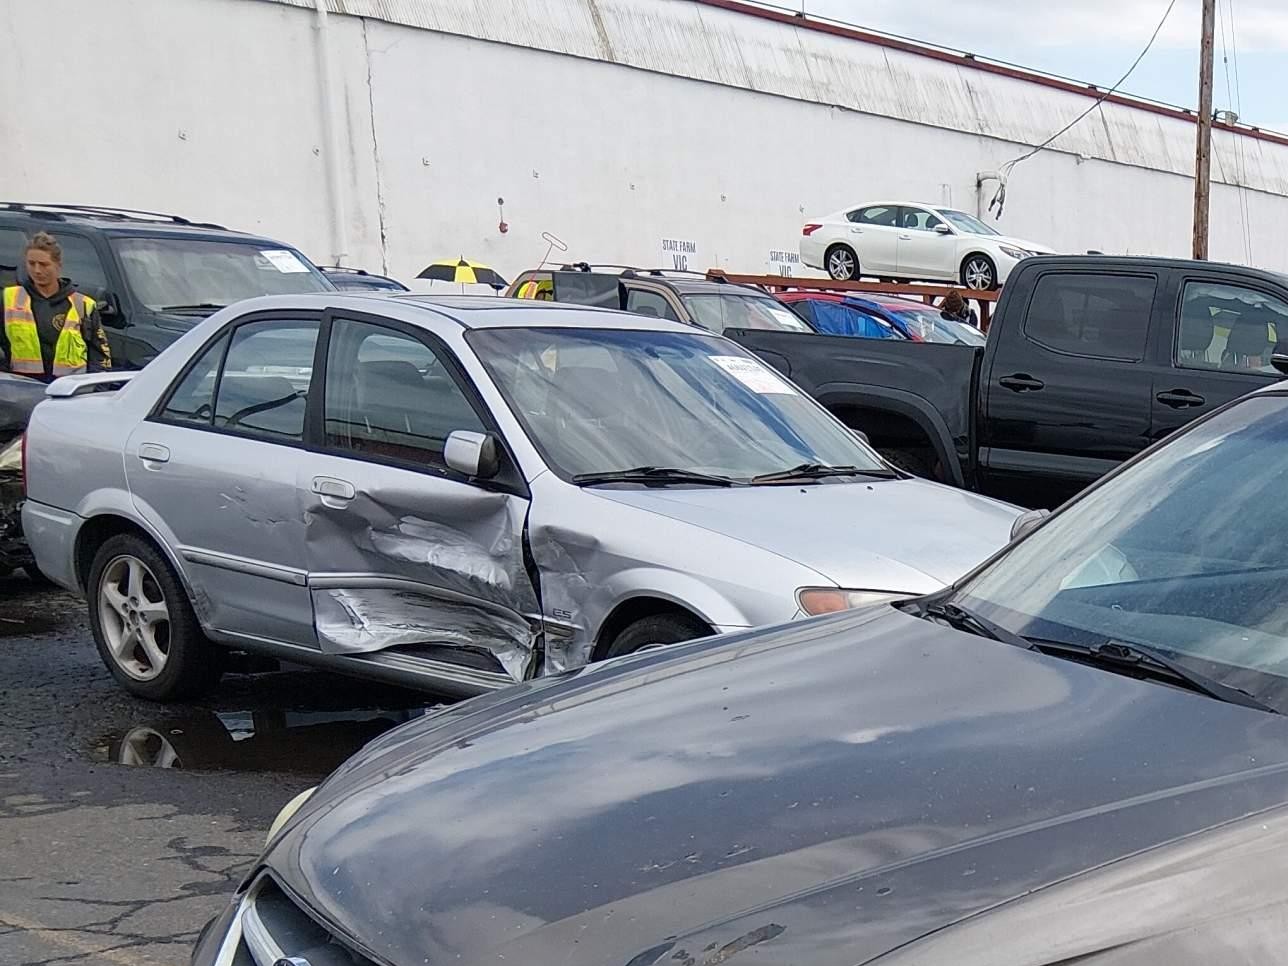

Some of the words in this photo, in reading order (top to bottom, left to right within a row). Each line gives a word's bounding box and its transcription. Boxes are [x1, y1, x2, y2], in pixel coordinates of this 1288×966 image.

[662, 239, 678, 251] STATE
[680, 240, 696, 253] FARM
[672, 254, 688, 271] VIC
[770, 250, 784, 262] STATE
[785, 251, 799, 263] FARM
[779, 264, 792, 278] VIC
